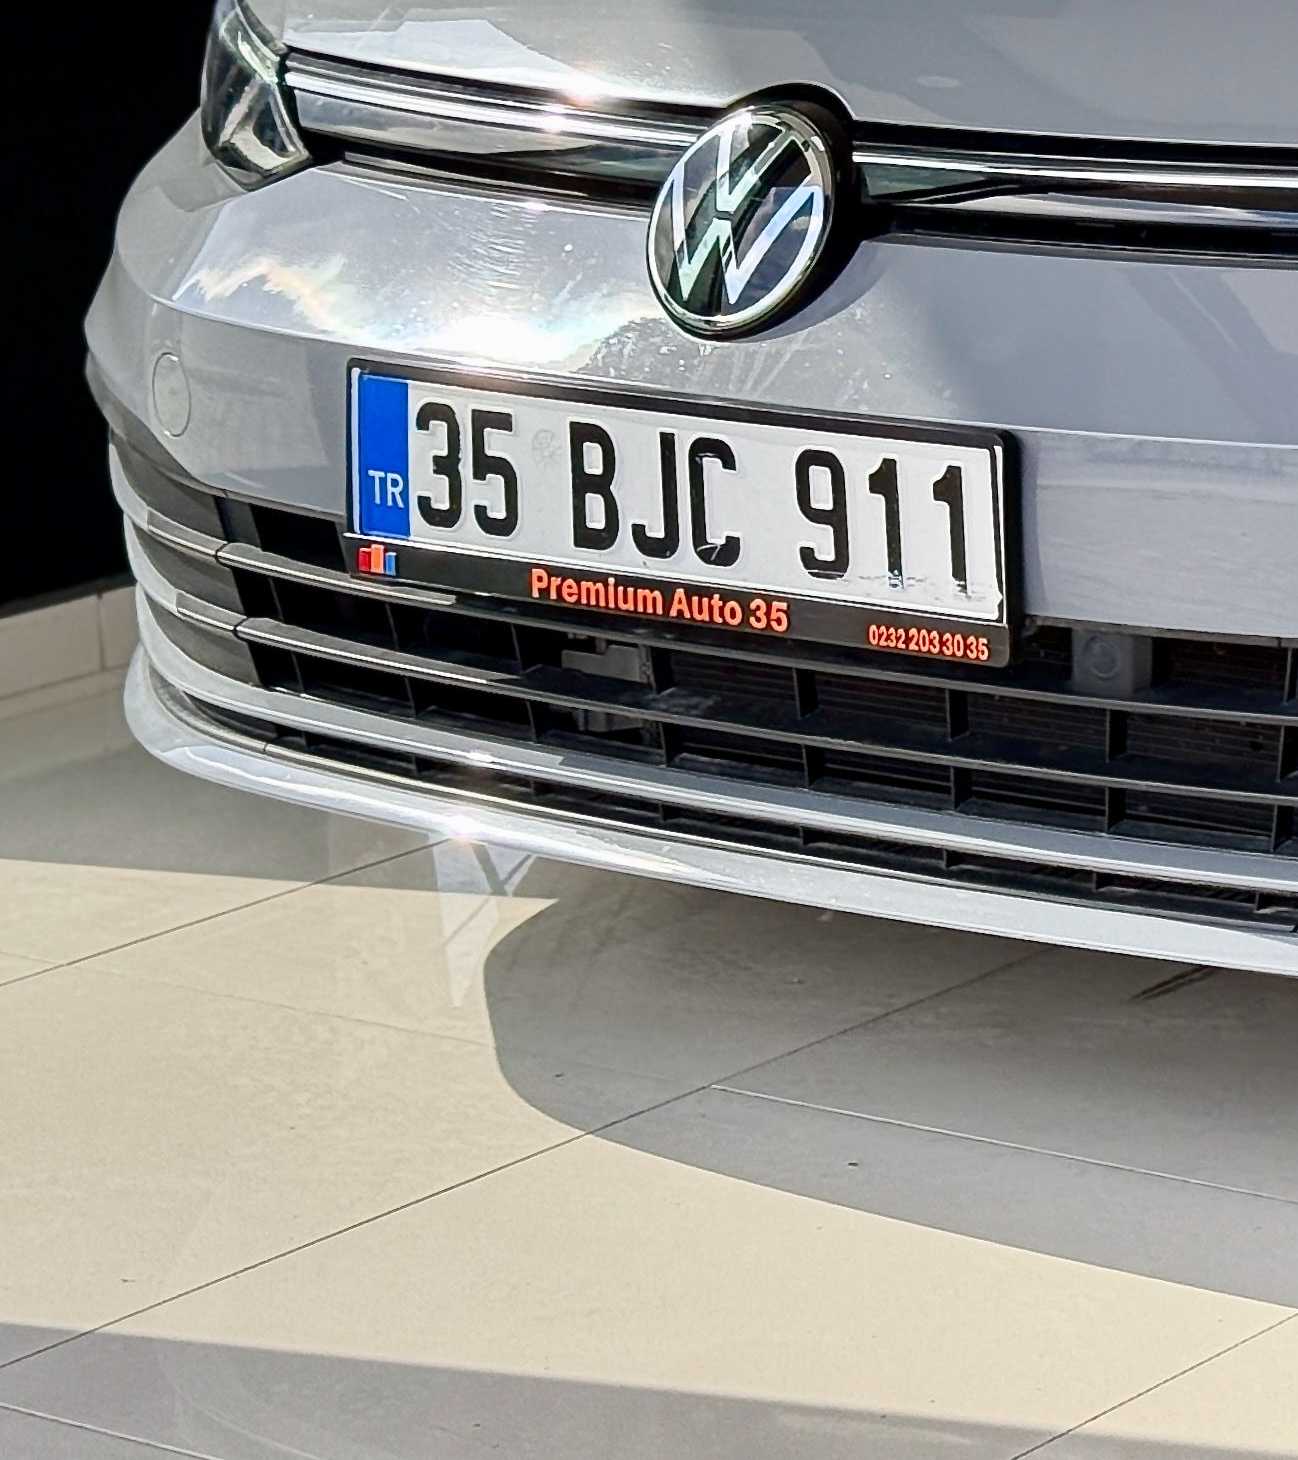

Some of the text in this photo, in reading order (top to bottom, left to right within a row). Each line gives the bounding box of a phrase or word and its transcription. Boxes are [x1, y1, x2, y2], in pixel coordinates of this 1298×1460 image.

[368, 469, 404, 509] TR
[416, 401, 968, 596] 35 BJC 911
[531, 568, 789, 633] Premium Auto 35
[868, 624, 989, 661] 0232 203 30 35
